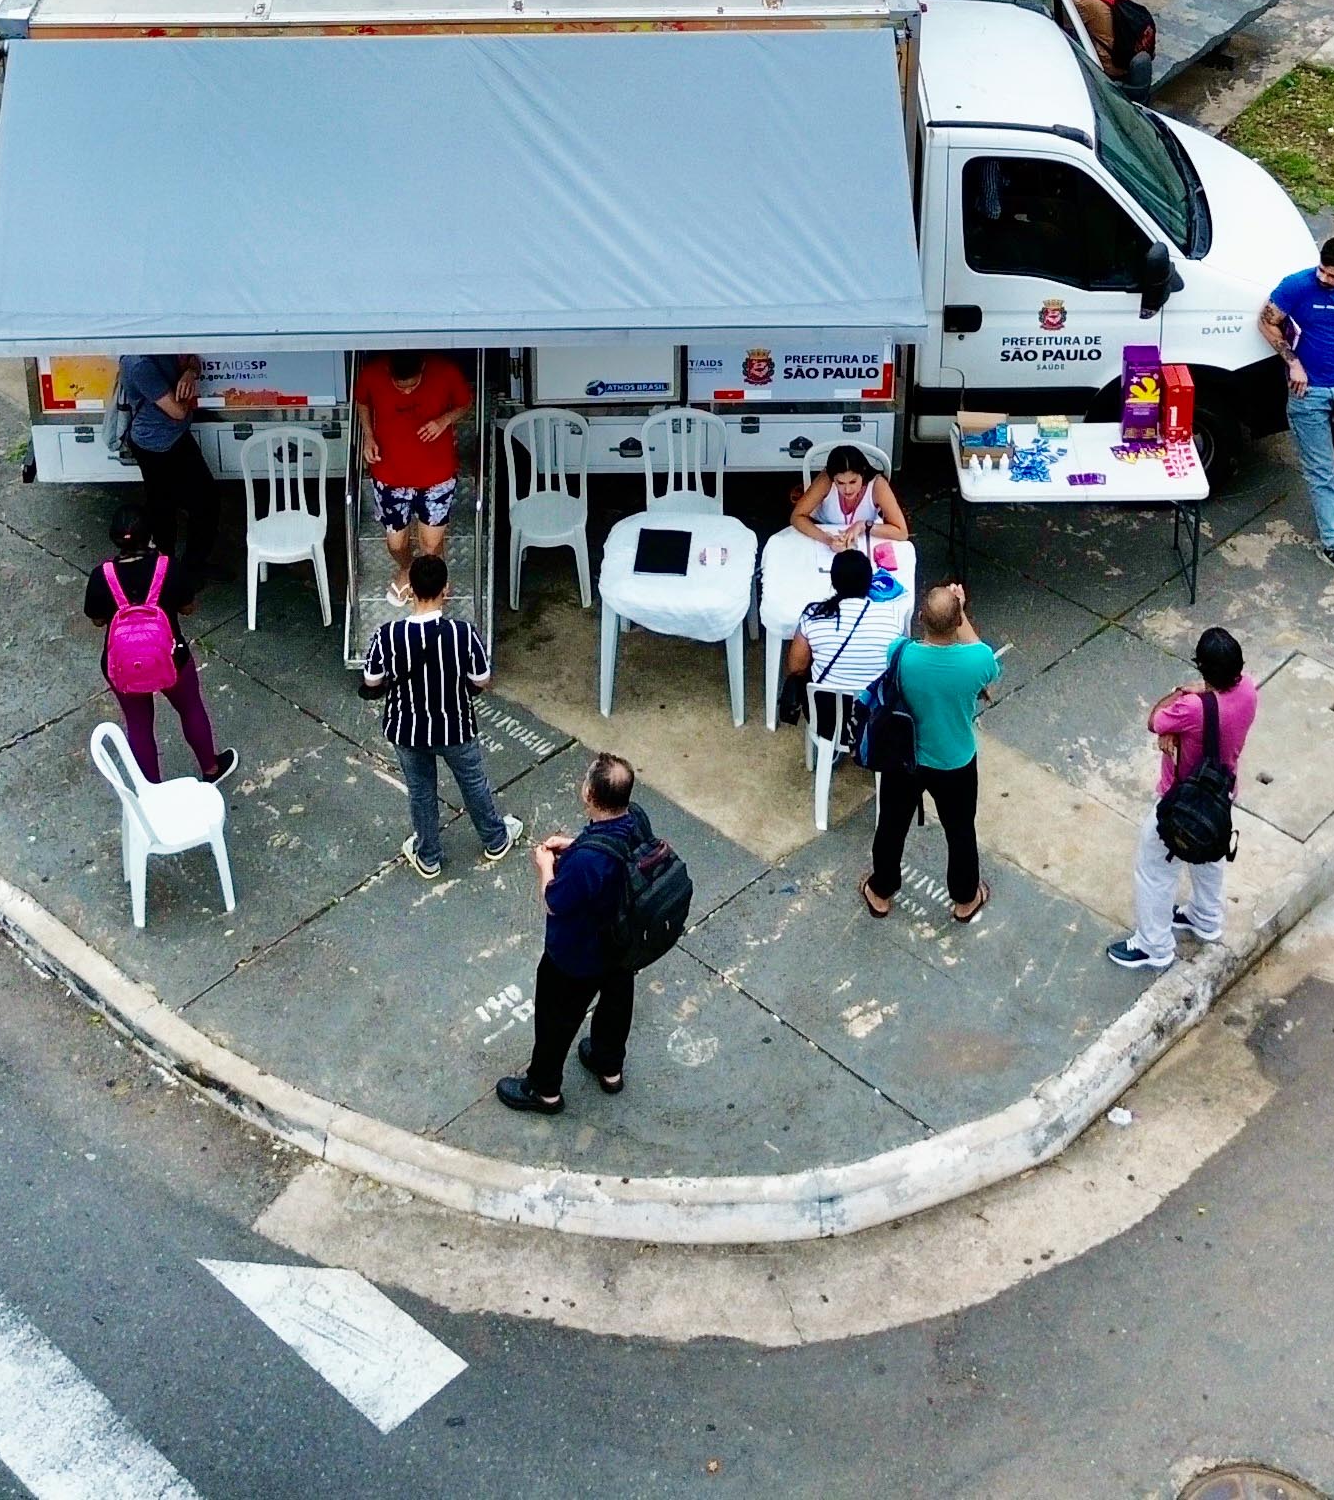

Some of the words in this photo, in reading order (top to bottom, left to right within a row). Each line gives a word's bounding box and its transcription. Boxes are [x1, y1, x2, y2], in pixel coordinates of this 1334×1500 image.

[1002, 336, 1081, 346] PREFEITURA
[1084, 336, 1102, 345] DE
[784, 354, 859, 364] PREFEITURA
[862, 354, 879, 364] DE
[1000, 347, 1038, 362] SÃO
[1042, 348, 1102, 362] PAULO
[1036, 363, 1065, 371] SAÚDE
[783, 365, 819, 380] SÃO
[822, 367, 880, 380] PAULO
[636, 383, 667, 392] BRASIL
